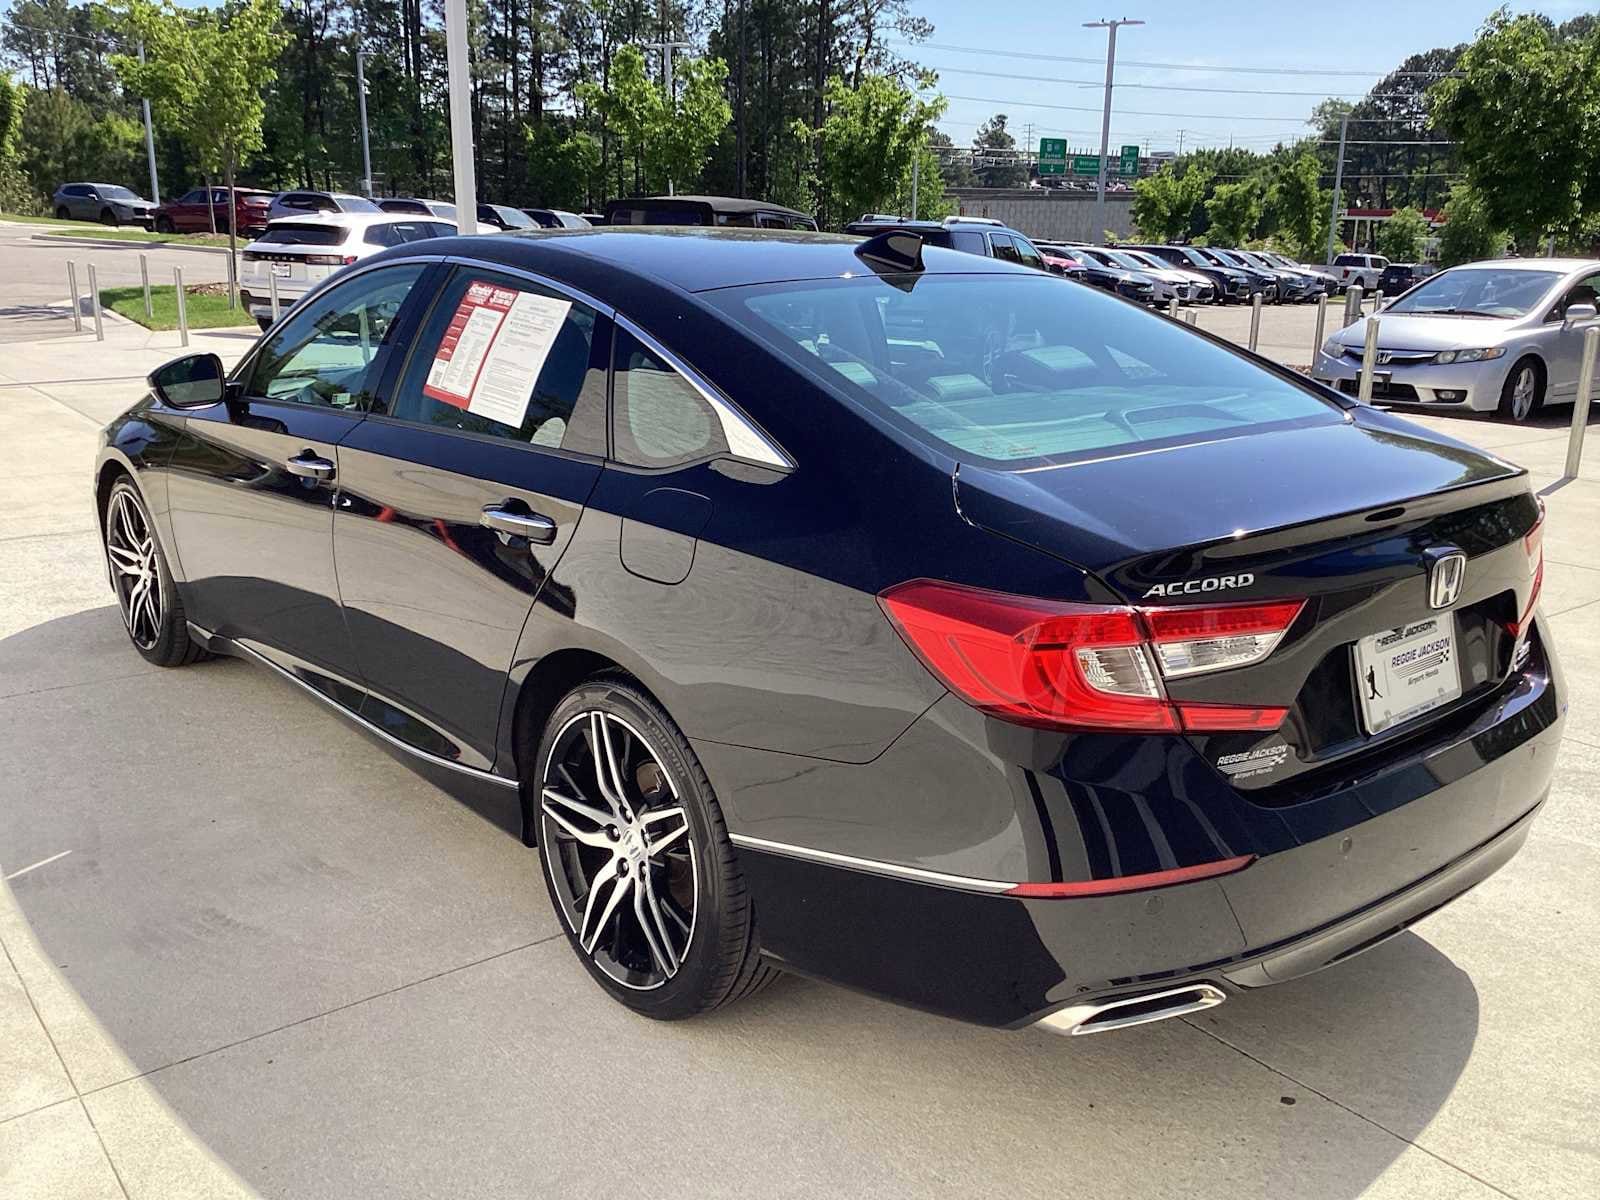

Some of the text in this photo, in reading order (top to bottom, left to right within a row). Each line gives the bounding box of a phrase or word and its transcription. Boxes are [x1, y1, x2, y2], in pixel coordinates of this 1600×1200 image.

[1142, 573, 1254, 599] ACCORD
[1405, 620, 1433, 638] JACKSON
[1391, 636, 1450, 668] REGGIE JACKSON
[1217, 744, 1288, 766] REGGIE JACKSON
